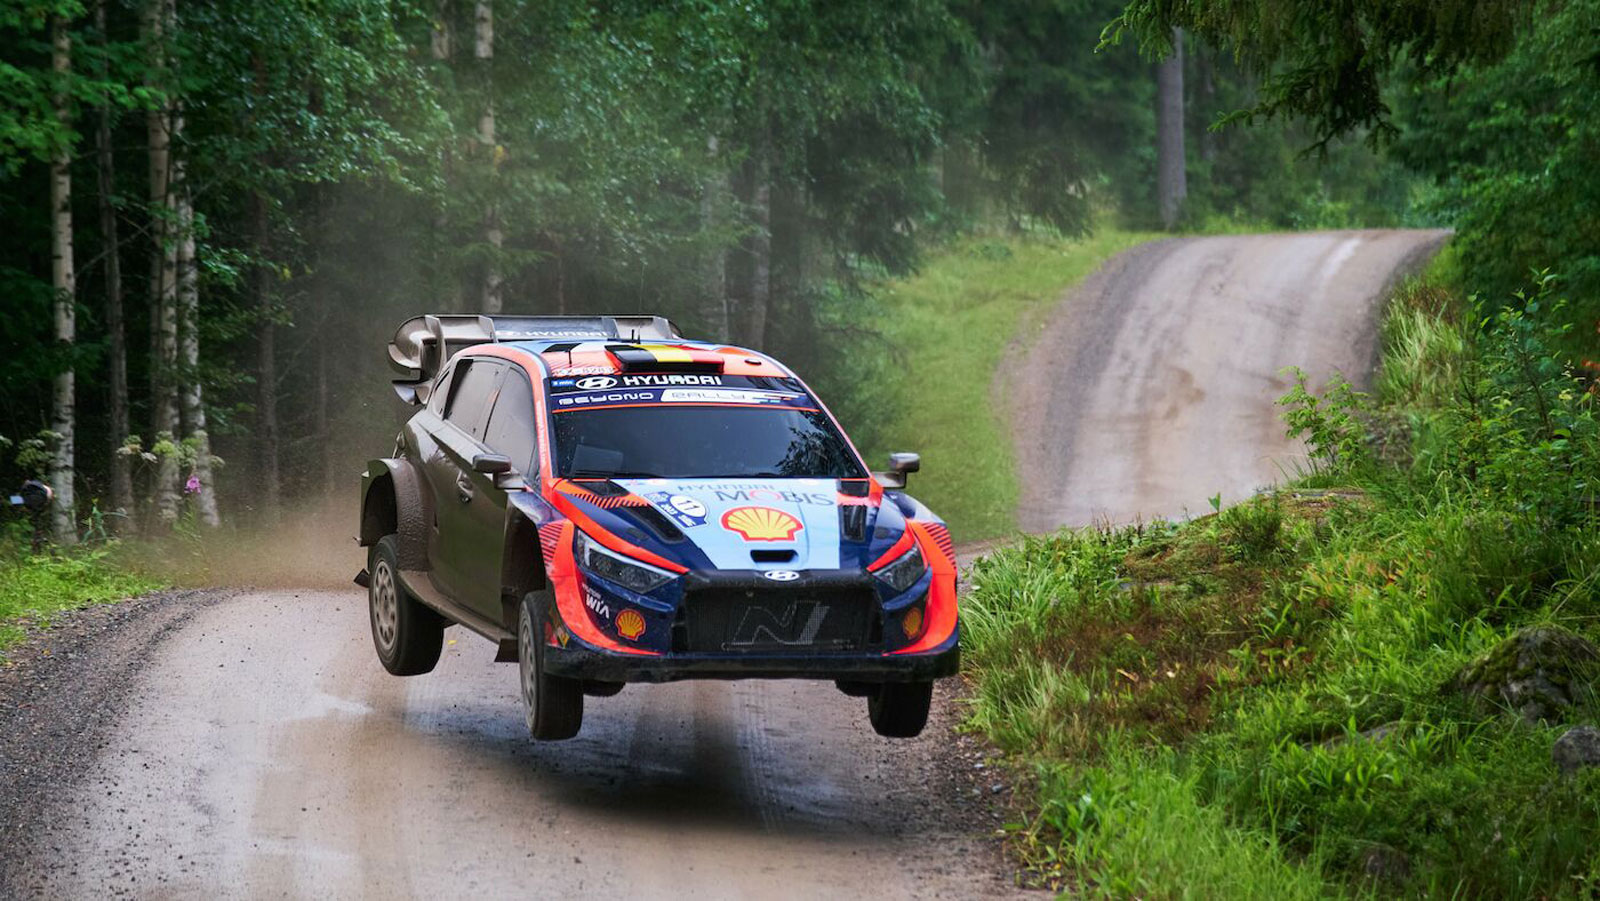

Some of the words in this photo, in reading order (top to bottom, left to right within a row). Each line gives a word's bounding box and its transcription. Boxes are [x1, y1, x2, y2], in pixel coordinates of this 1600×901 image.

[623, 375, 722, 386] HYUNDAI
[558, 392, 654, 405] BEYOND
[714, 490, 834, 506] MOBIS
[677, 500, 700, 510] 11
